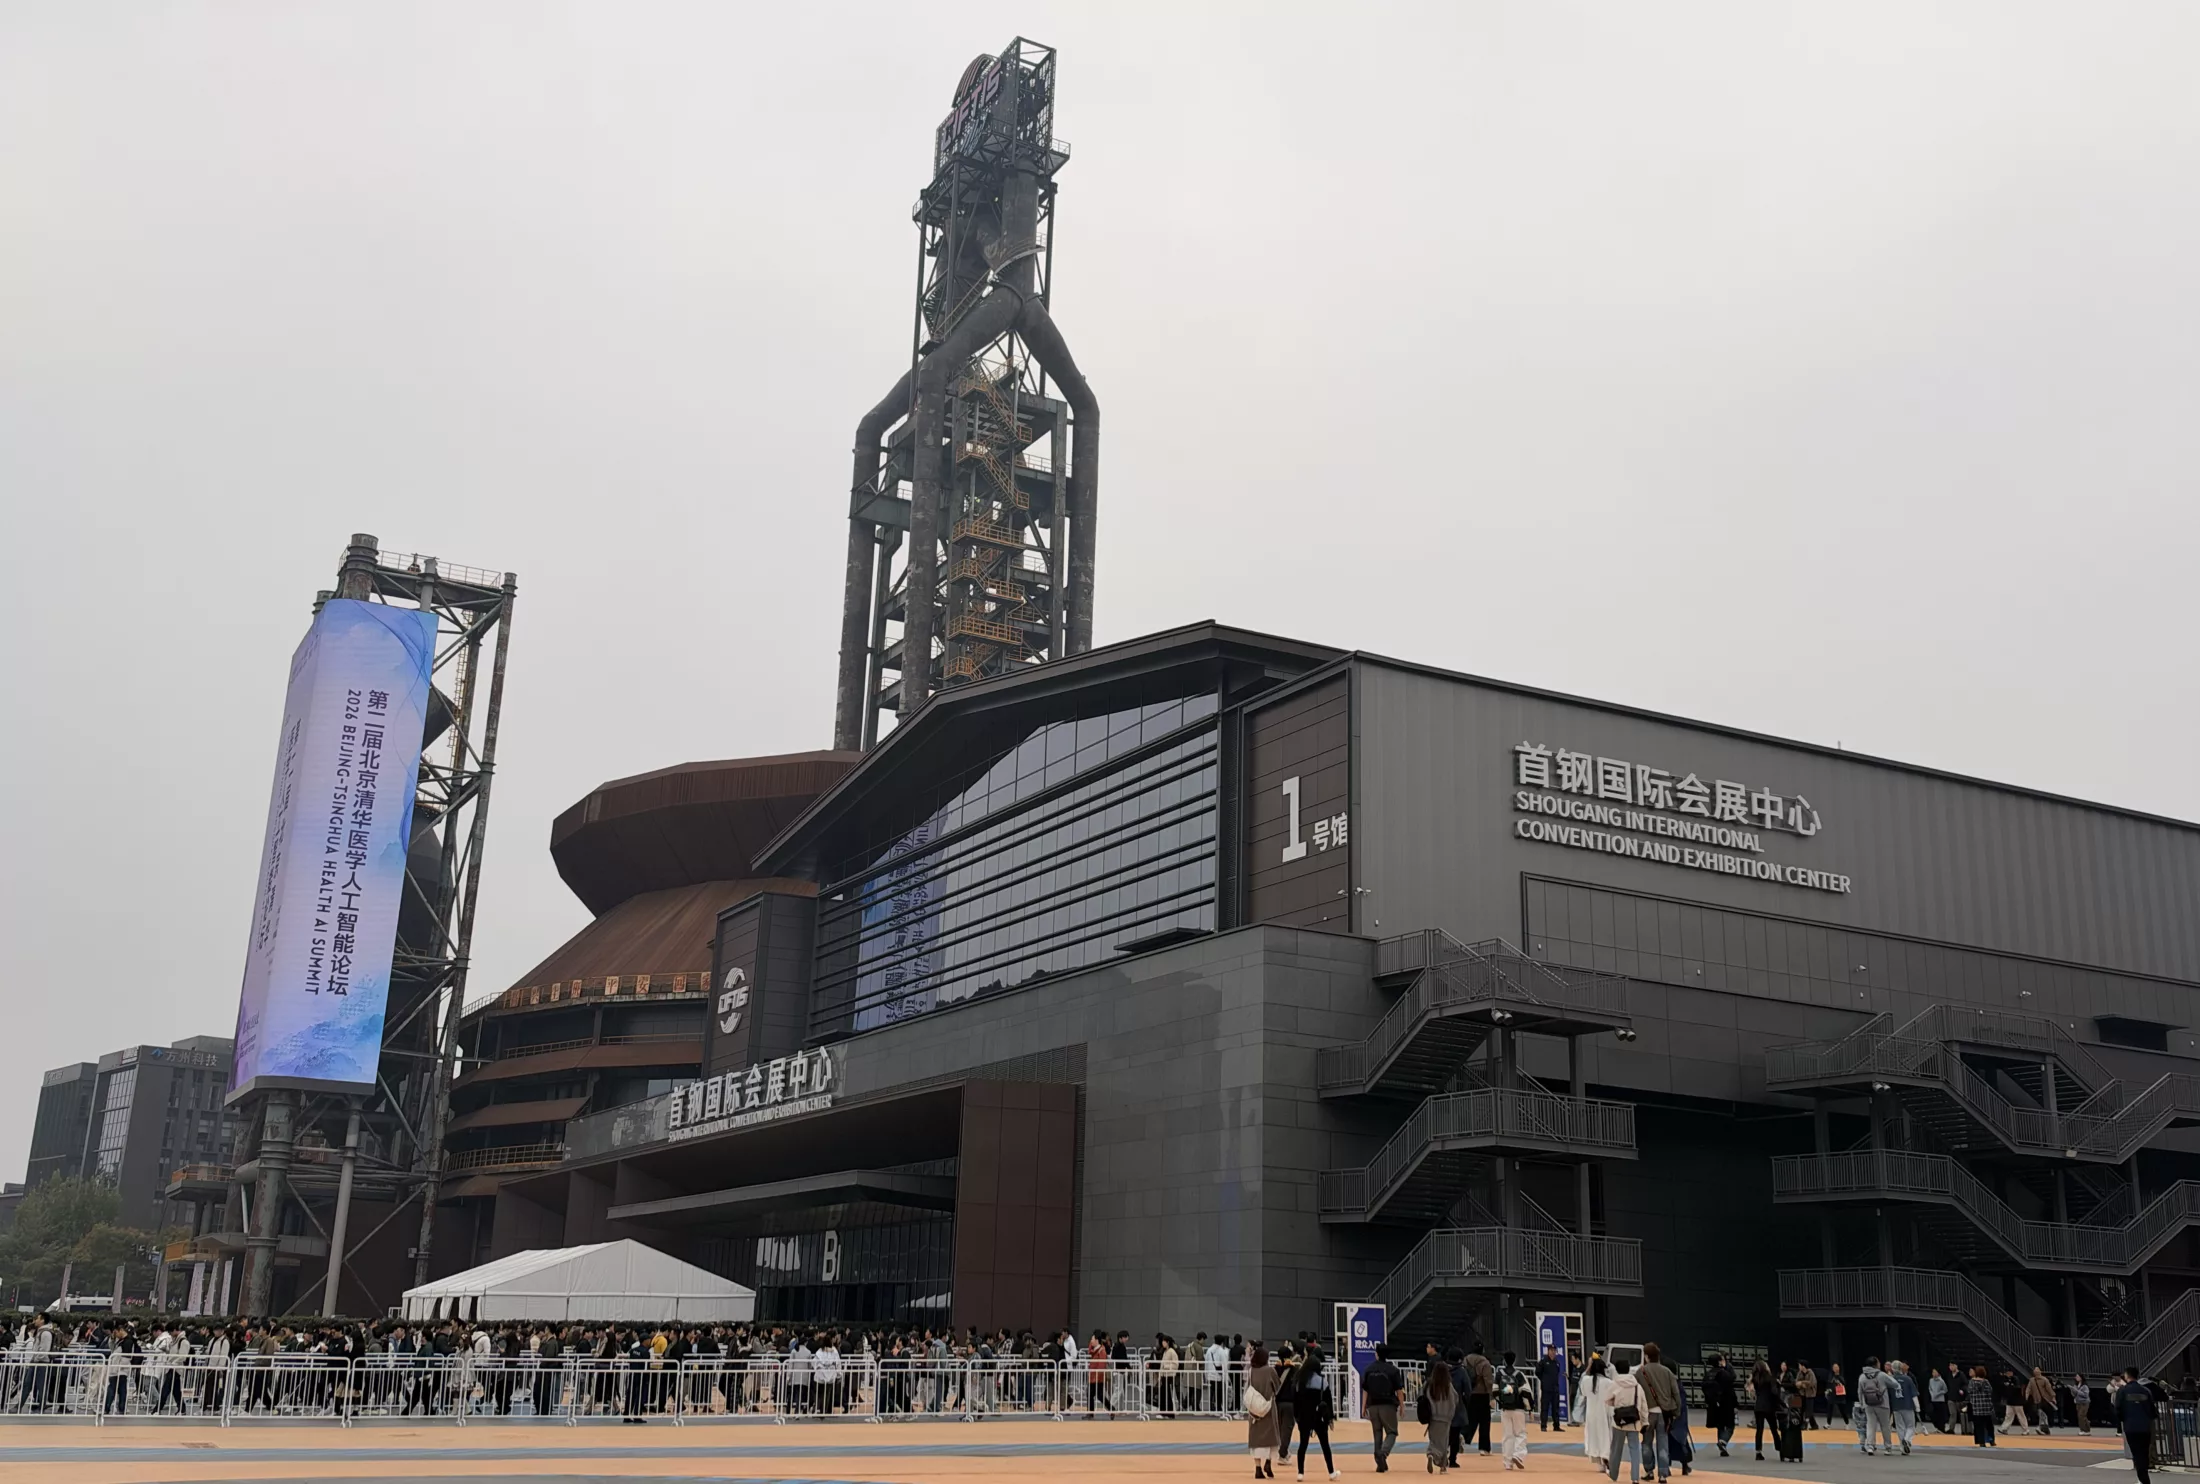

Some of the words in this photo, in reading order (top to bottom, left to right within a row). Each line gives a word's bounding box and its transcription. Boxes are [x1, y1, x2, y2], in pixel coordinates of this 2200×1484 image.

[345, 689, 362, 720] 2026
[325, 725, 357, 854] BEIJING-TSINGHUA
[1514, 740, 1822, 836] 首钢国际会展中心
[326, 690, 389, 996] 第二届北京清华医学人工智能论坛
[1516, 790, 1622, 827] SHOUGANG
[1625, 807, 1765, 853] INTERNATIONAL
[1517, 819, 1642, 857] CONVENTION
[1642, 841, 1681, 864] AND
[1684, 849, 1783, 882] EXHIBITION
[1785, 866, 1851, 893] CENTER
[316, 860, 337, 913] HEALTH
[314, 918, 329, 932] AI
[305, 938, 326, 995] SUMMIT
[166, 1051, 218, 1067] 方州科技
[669, 1046, 832, 1129] 首钢国际会展中心
[806, 1094, 832, 1112] CENTER
